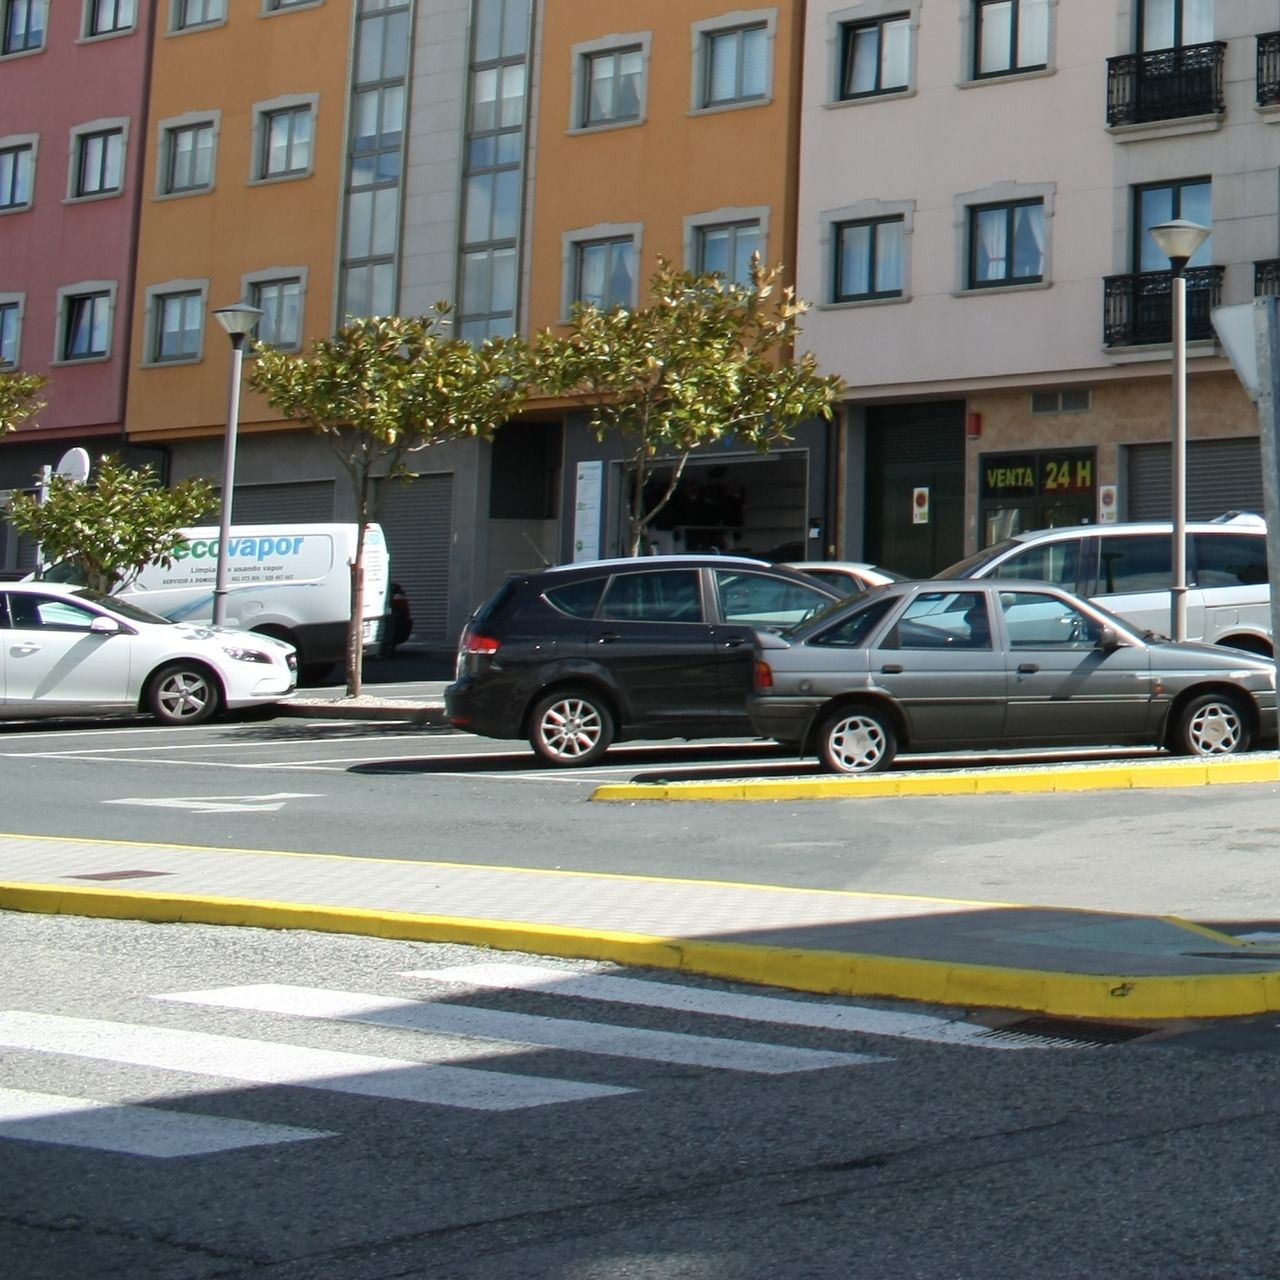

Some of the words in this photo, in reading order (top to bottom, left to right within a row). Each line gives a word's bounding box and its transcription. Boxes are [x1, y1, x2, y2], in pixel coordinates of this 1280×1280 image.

[986, 467, 1034, 489] VENTA
[1045, 461, 1071, 490] 24
[1076, 461, 1092, 488] H
[263, 564, 284, 572] vapor
